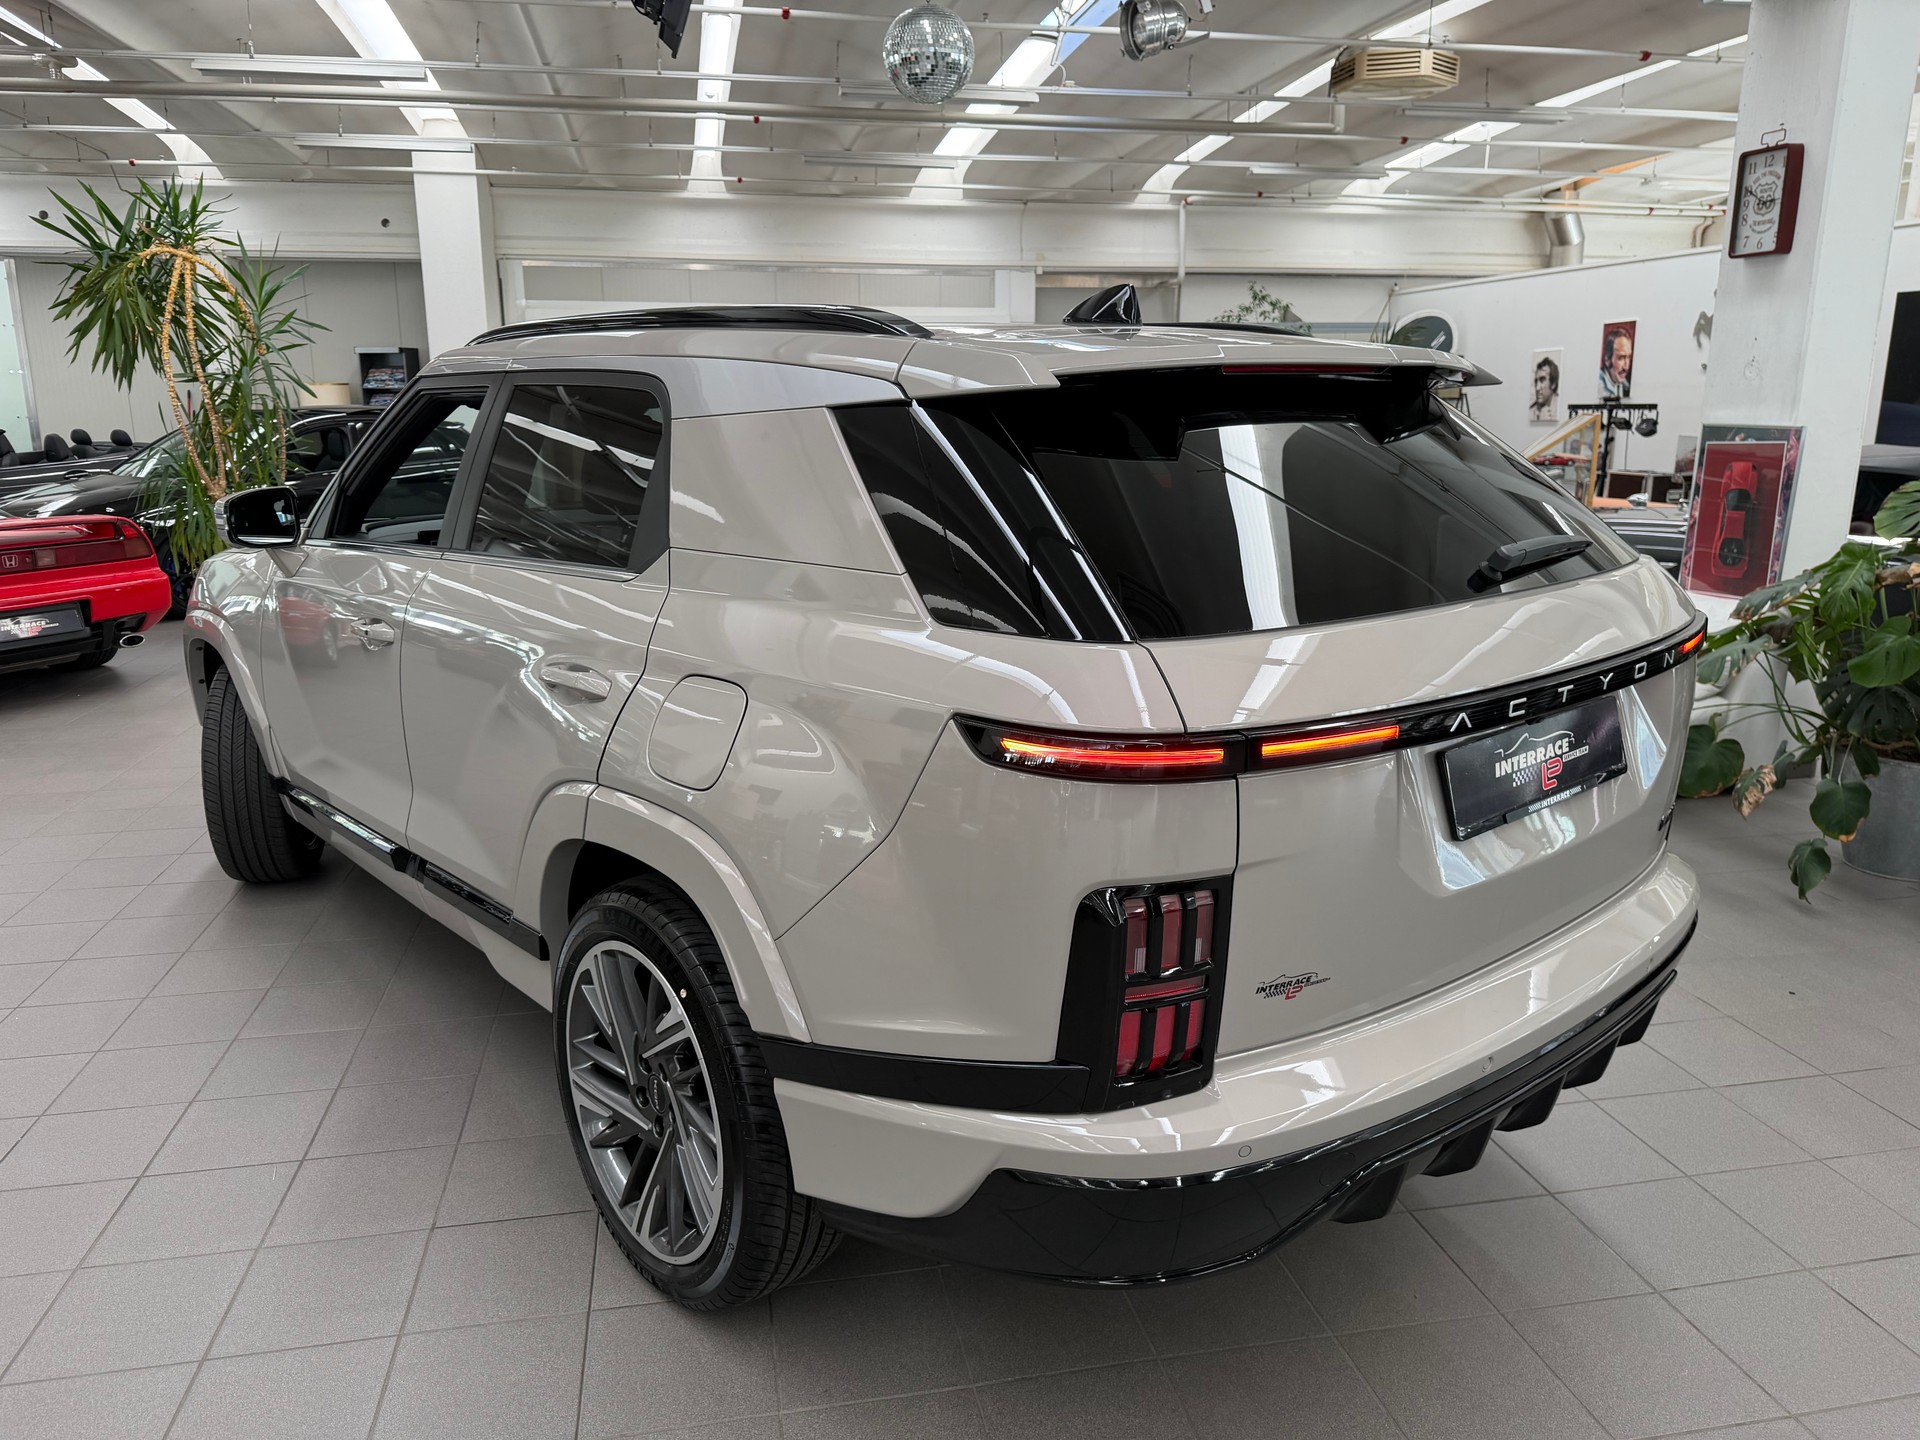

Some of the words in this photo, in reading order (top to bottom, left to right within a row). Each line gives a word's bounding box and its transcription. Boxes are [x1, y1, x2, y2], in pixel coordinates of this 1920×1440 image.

[1764, 154, 1775, 168] 12
[1748, 162, 1757, 175] 11
[1760, 186, 1773, 194] ROUTE
[1743, 199, 1750, 212] 9
[1741, 213, 1748, 226] 8
[1743, 235, 1750, 248] 7
[1756, 237, 1763, 250] 6
[1, 620, 46, 631] INTERRACE
[1495, 737, 1569, 778] INTERRACE
[1541, 790, 1570, 808] INTERRACE
[1255, 975, 1312, 994] INTERRACE
